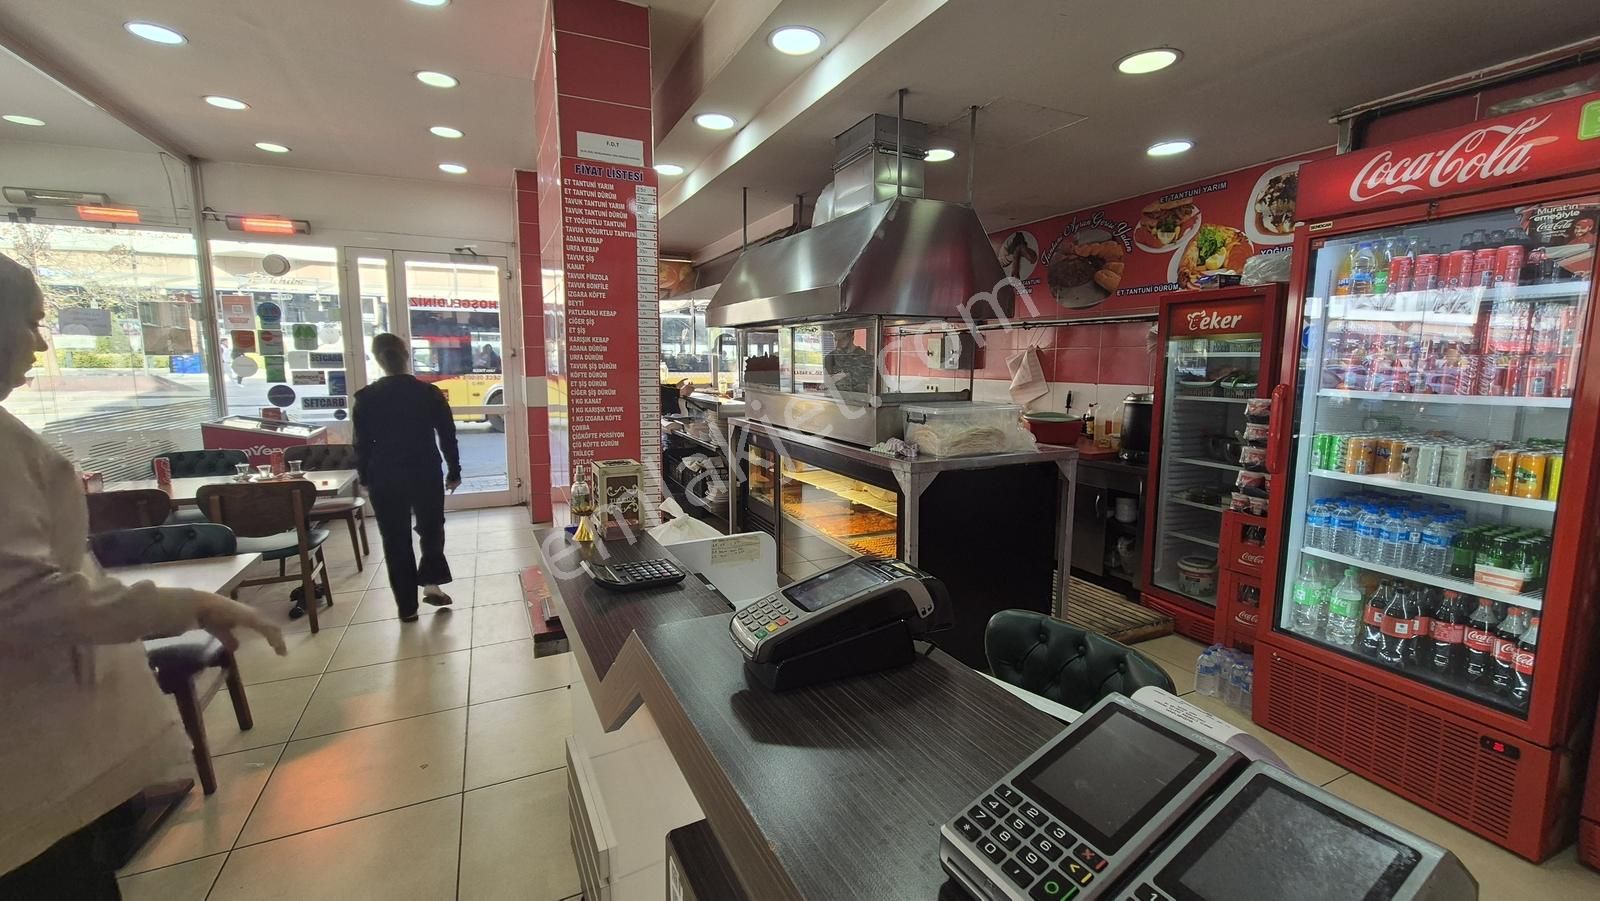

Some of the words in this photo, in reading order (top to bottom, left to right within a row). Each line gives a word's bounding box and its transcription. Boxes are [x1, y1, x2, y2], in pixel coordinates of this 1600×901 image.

[1350, 112, 1553, 202] Coca-Cola
[1171, 189, 1201, 200] TANTUNİ
[1202, 182, 1227, 192] YARIM
[1126, 287, 1153, 295] TANTUNİ
[1154, 283, 1179, 293] DÜRÜM
[304, 398, 345, 408] SETCARD
[988, 800, 999, 809] 4
[1013, 819, 1024, 830] 5
[1040, 840, 1051, 851] 6
[1027, 808, 1038, 818] 2
[1053, 828, 1066, 839] 3
[976, 811, 986, 821] 7
[1000, 831, 1011, 842] 8
[1026, 853, 1038, 864] 9
[984, 843, 996, 854] 0
